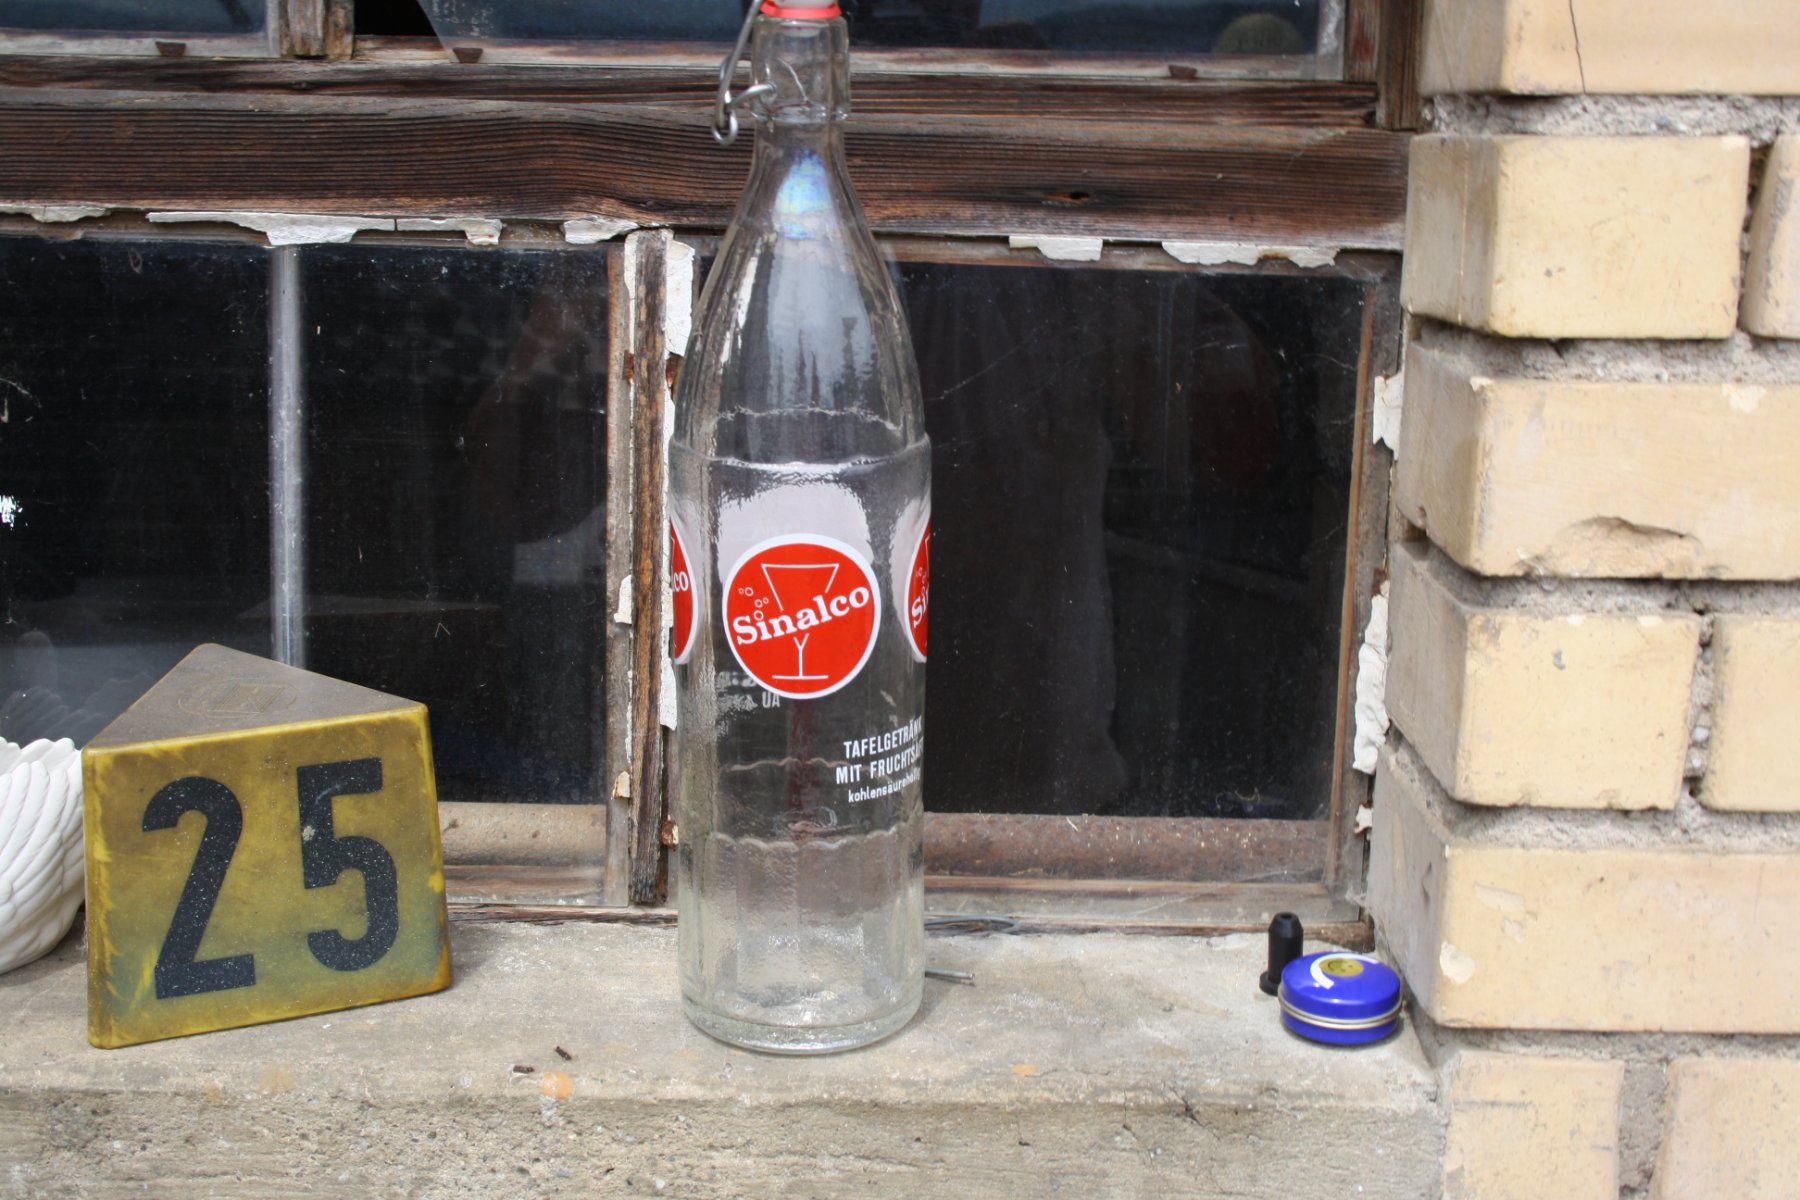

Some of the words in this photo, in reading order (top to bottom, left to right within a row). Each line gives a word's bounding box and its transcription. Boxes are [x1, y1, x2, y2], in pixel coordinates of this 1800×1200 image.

[733, 586, 870, 646] Sinalco
[836, 764, 862, 784] MIT
[142, 757, 398, 1000] 25
